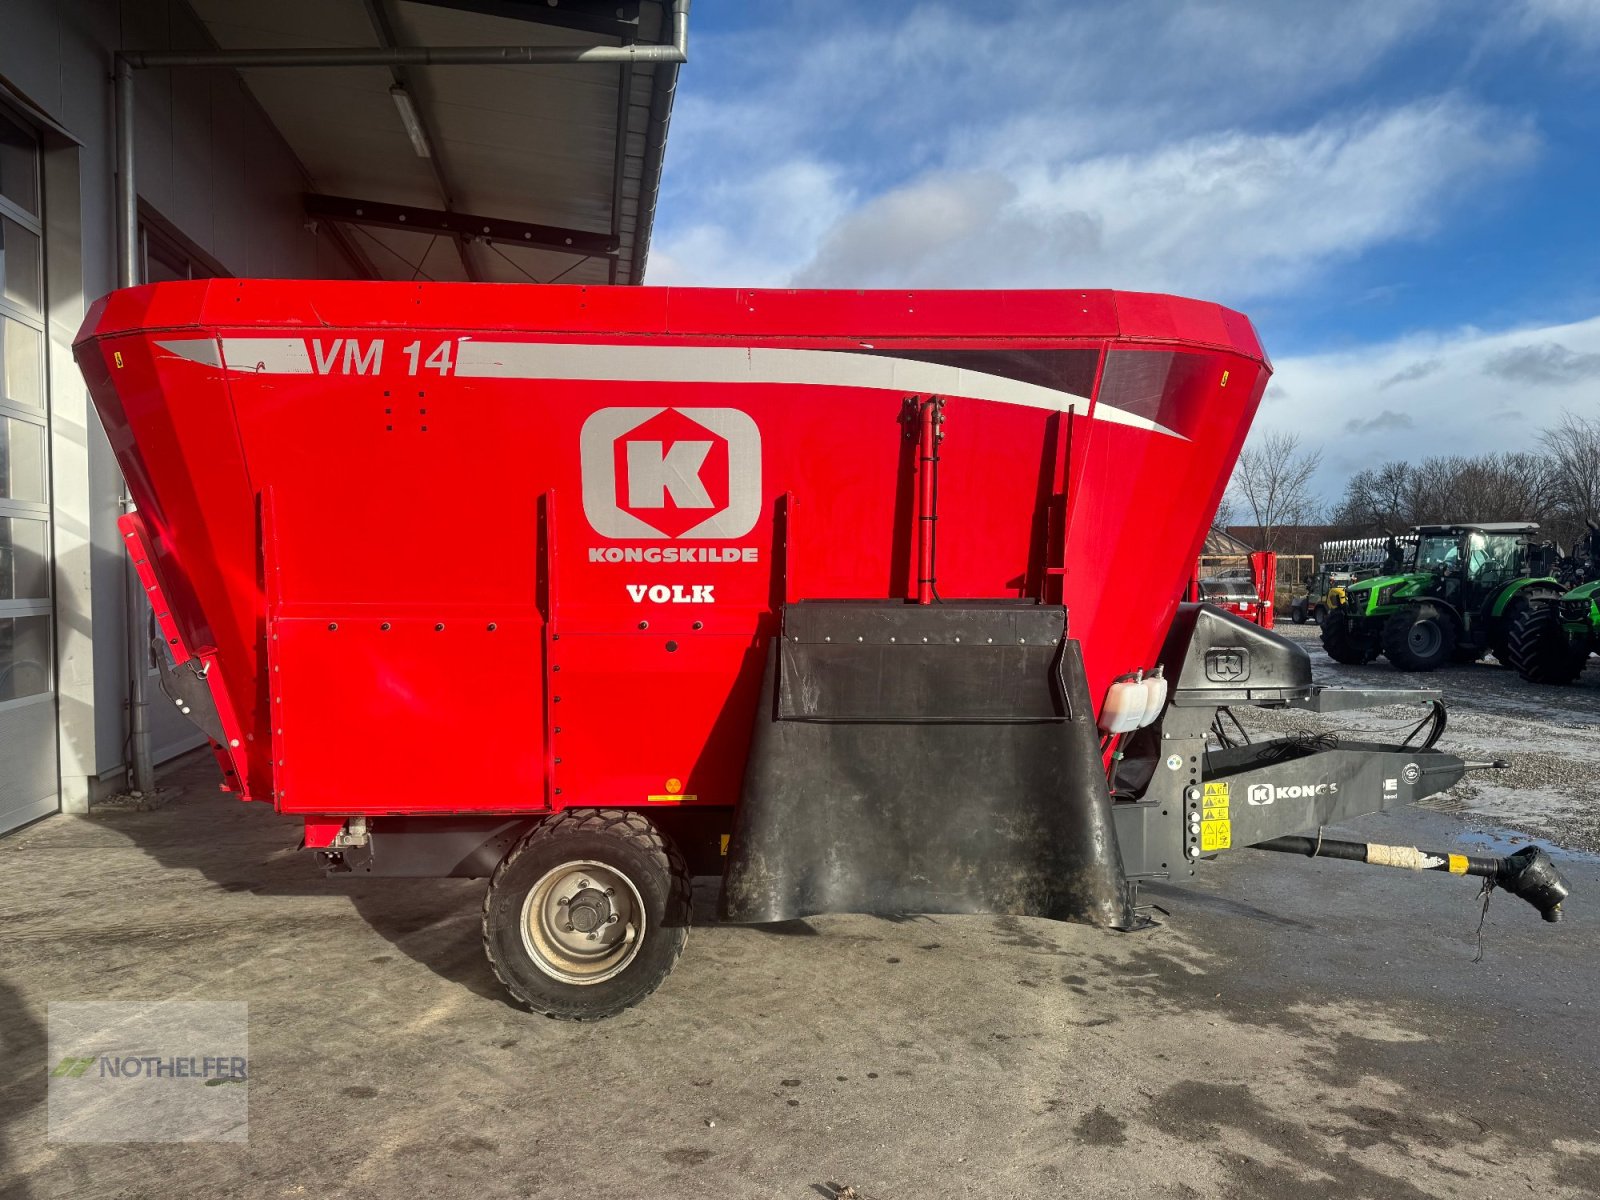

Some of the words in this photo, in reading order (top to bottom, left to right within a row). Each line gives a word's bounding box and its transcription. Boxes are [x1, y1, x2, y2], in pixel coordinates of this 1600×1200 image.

[312, 338, 385, 376] VM
[402, 340, 453, 376] 14
[626, 440, 716, 509] K
[588, 547, 759, 563] KONGSKILDE
[626, 584, 715, 604] VOLK
